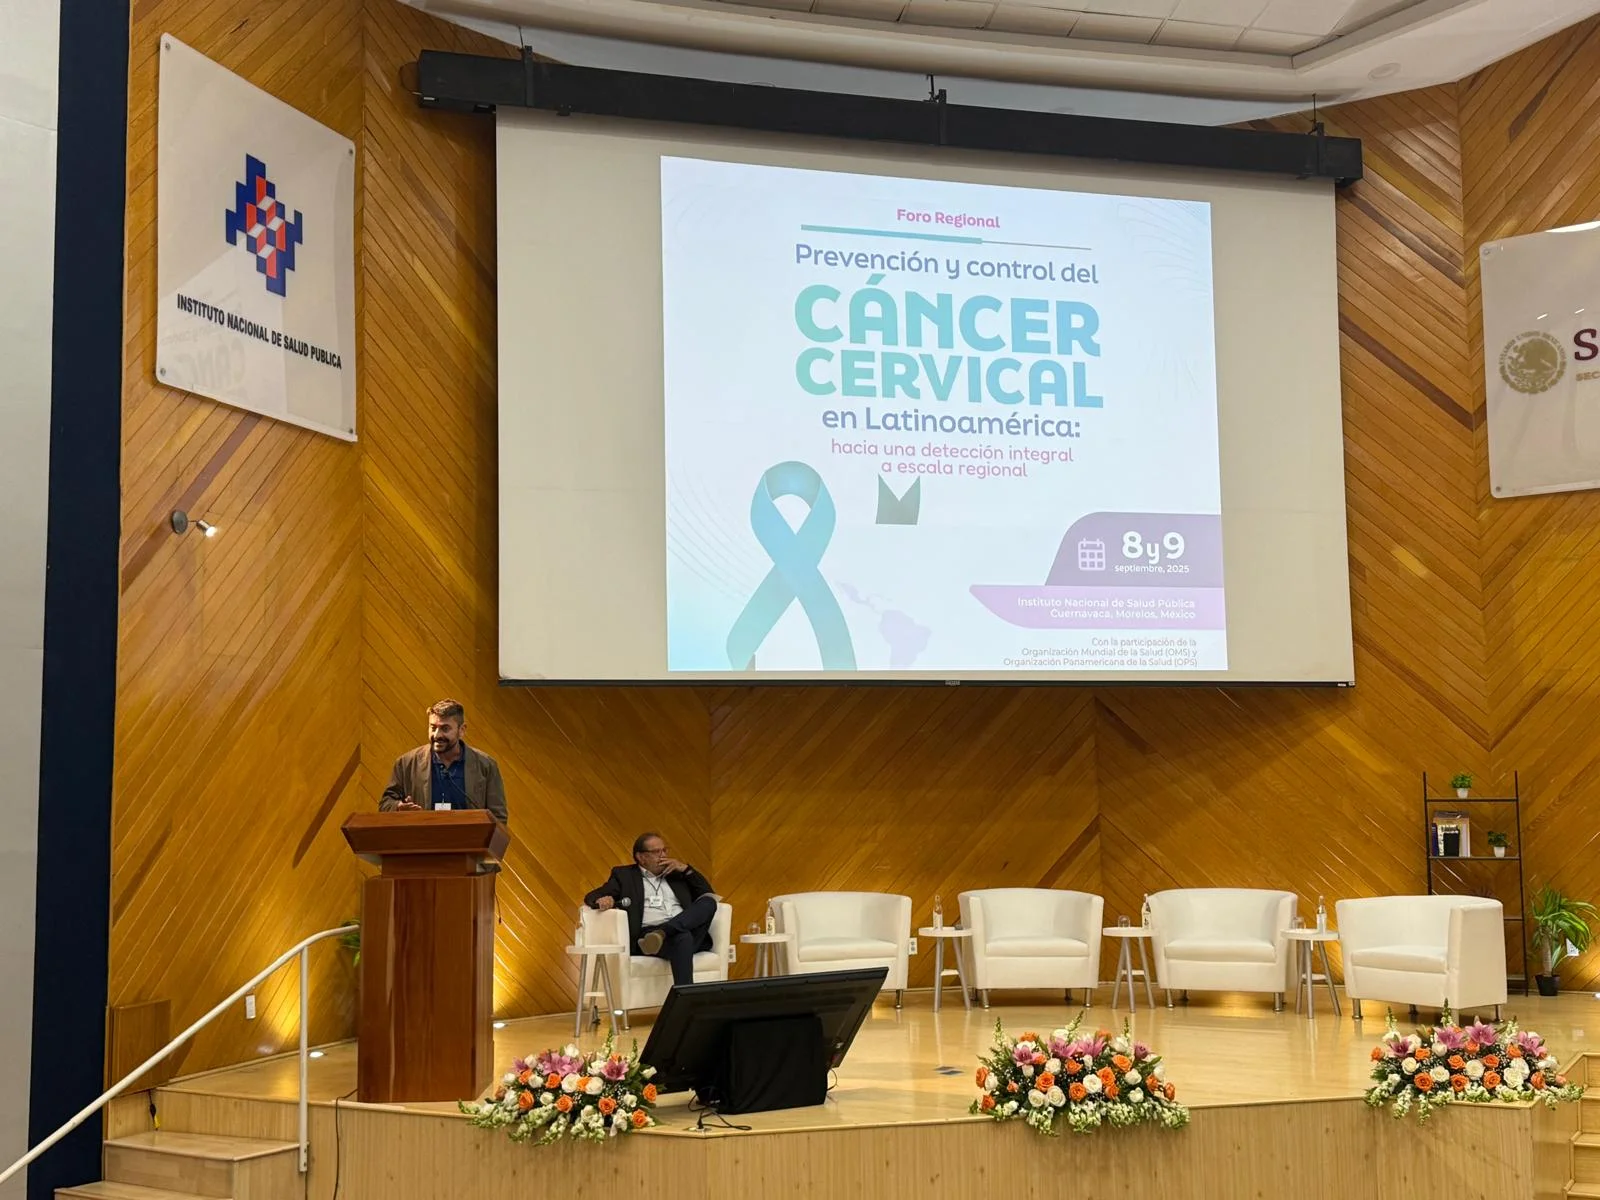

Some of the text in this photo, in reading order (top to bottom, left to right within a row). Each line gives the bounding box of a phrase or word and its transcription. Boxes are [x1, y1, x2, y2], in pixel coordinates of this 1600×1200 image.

[897, 208, 1000, 229] Foro Regional
[796, 243, 1099, 284] Prevención y control del
[794, 273, 1102, 357] CÁNCER
[177, 293, 225, 326] INSTITUTO
[227, 312, 269, 343] NACIONAL
[271, 330, 282, 347] DE
[283, 335, 309, 357] SALUD
[310, 345, 342, 370] PUBLICA
[1574, 328, 1599, 361] S
[795, 347, 1104, 409] CERVICAL
[822, 407, 1081, 438] en Latinoamérica:
[831, 438, 1074, 465] hacia una detección integral
[881, 459, 1028, 479] a escala regional
[1114, 564, 1190, 574] septiembre, 2025
[1018, 597, 1195, 609] Instituto Nacional de Salud Pública
[1050, 608, 1113, 620] Cuernavaca,
[1021, 647, 1198, 658] Organización Mundial de la Salud (OMS) y
[1092, 637, 1197, 648] Con la participación de la
[1003, 658, 1198, 668] Organización Panamericana de la Salud (OPS)
